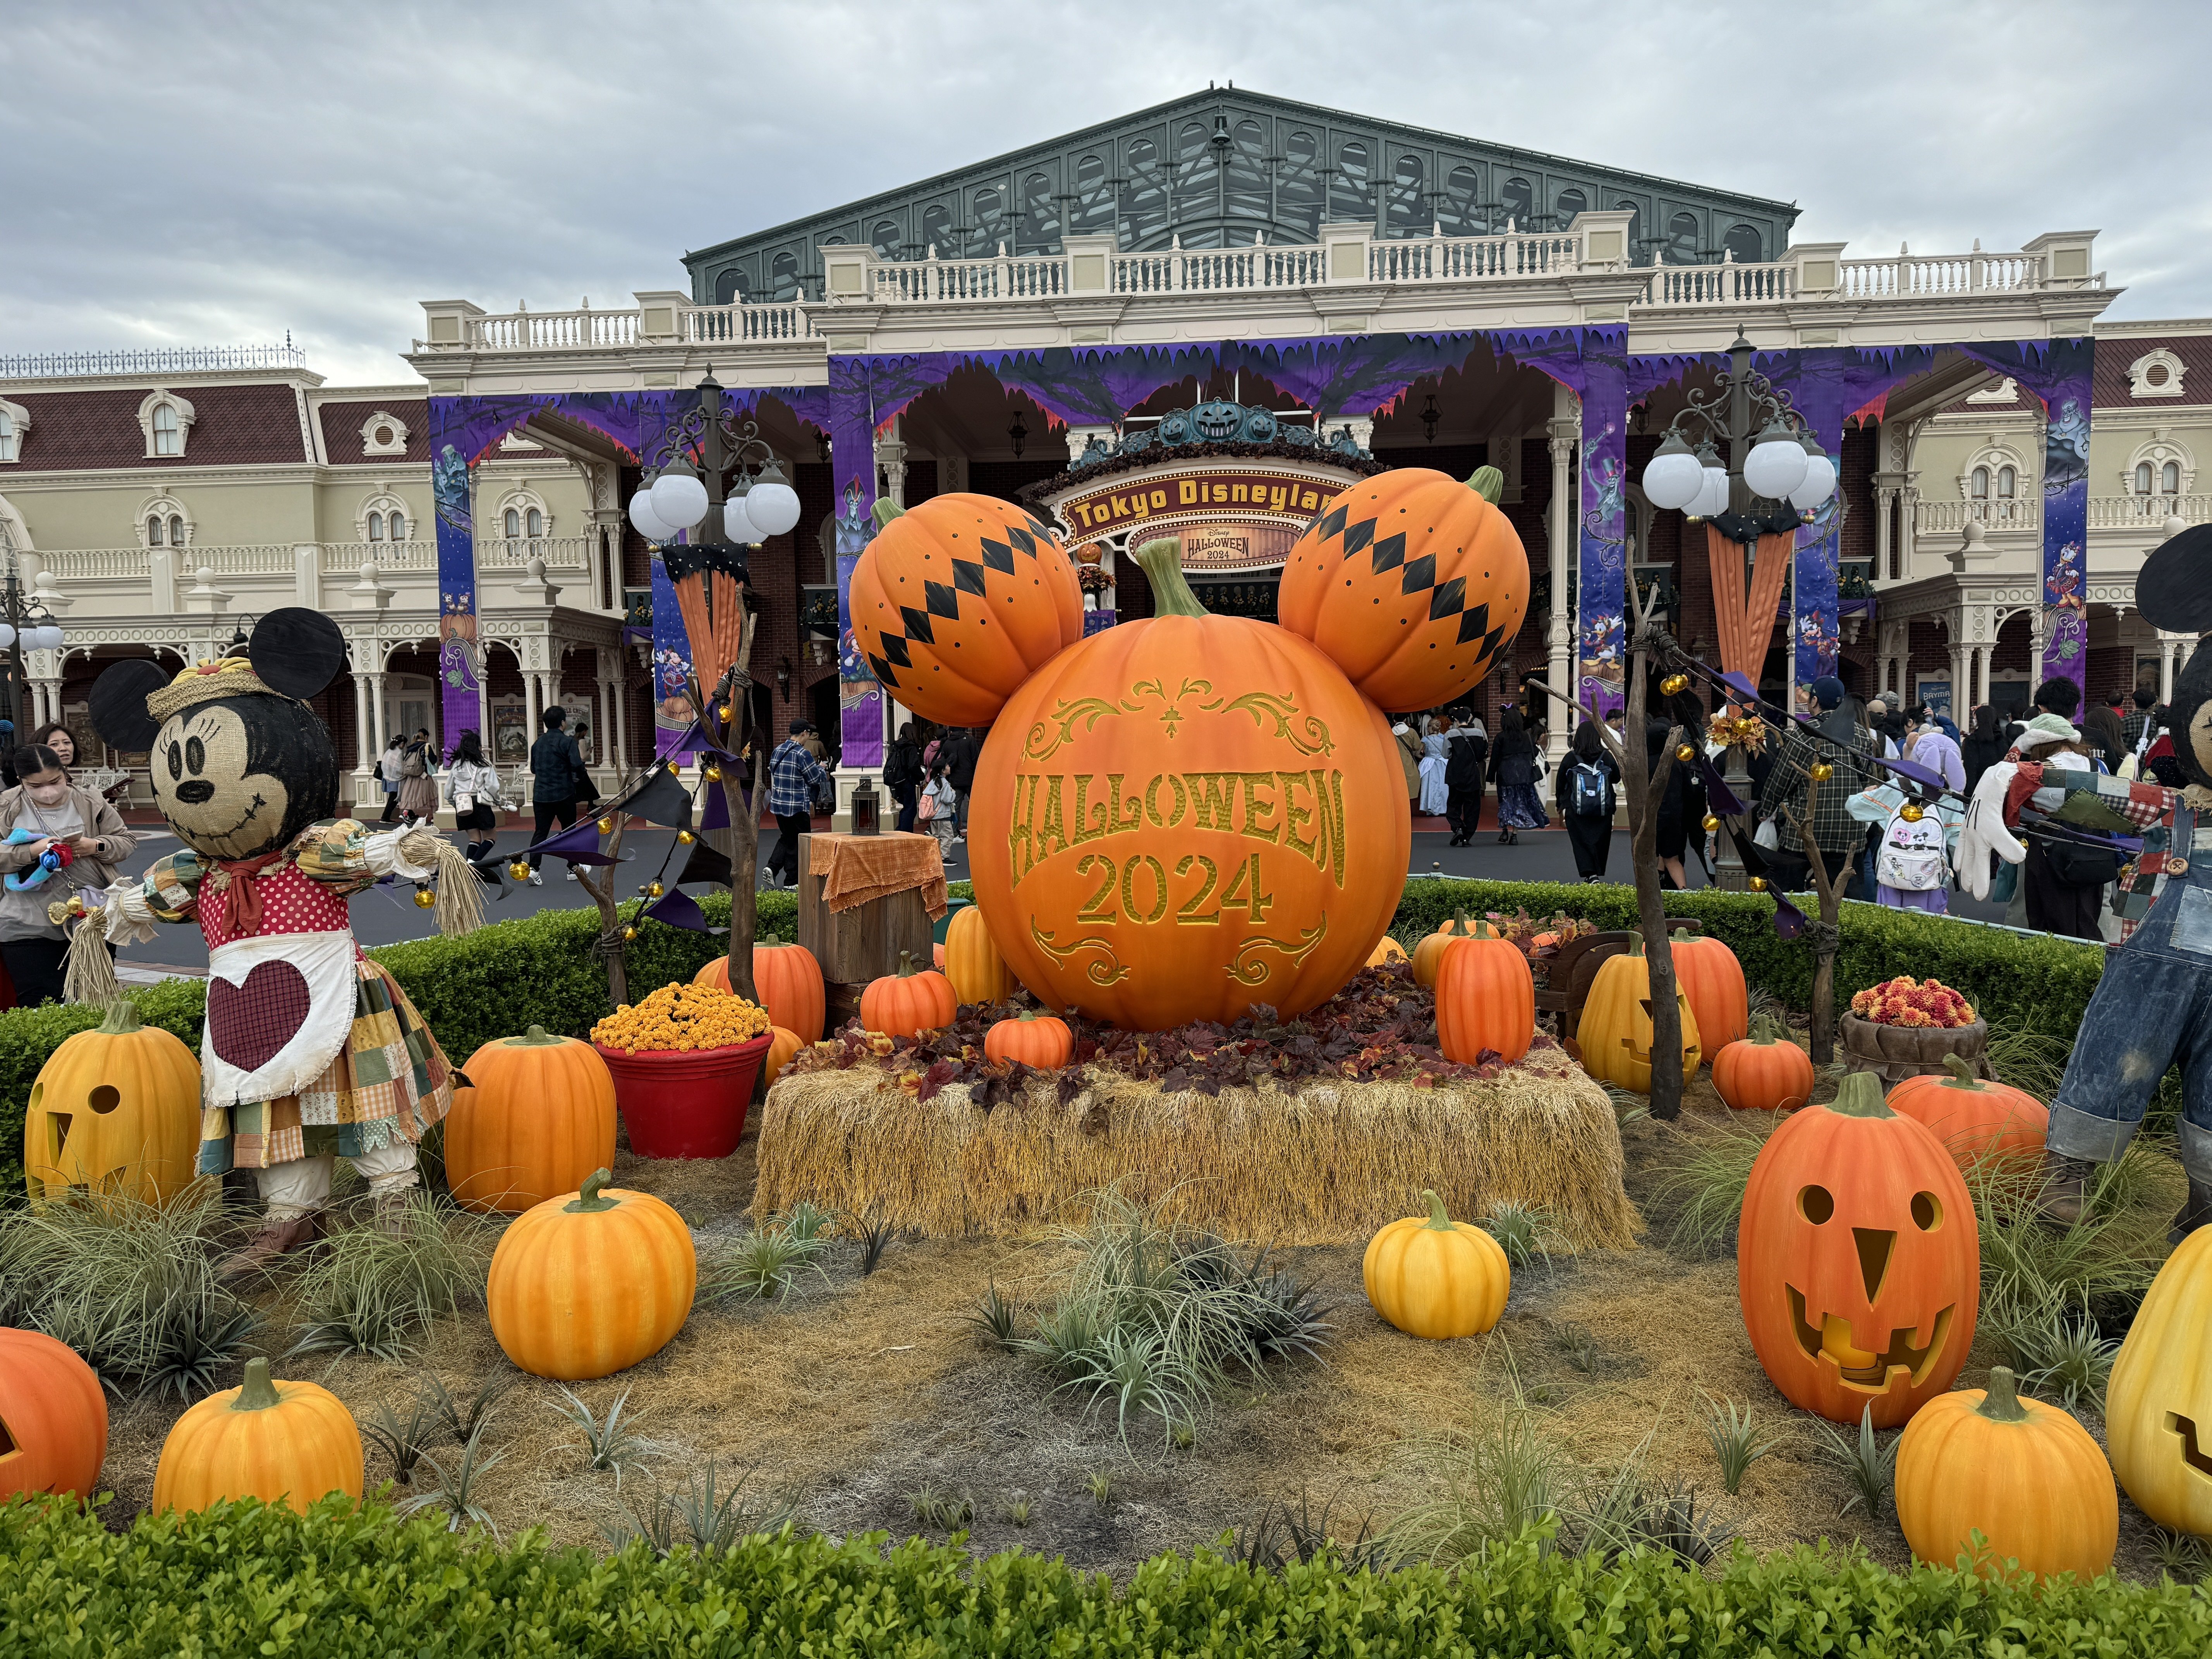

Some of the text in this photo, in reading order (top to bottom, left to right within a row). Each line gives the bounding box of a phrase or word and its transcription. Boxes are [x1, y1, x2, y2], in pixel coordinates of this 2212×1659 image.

[1074, 490, 1167, 528] Tokyo
[1207, 528, 1230, 537] Disney
[1188, 537, 1249, 559] HALLOWEEN
[1207, 550, 1230, 559] 2024
[1008, 769, 1346, 892] HALLOWEEN
[1075, 853, 1273, 926] 2024
